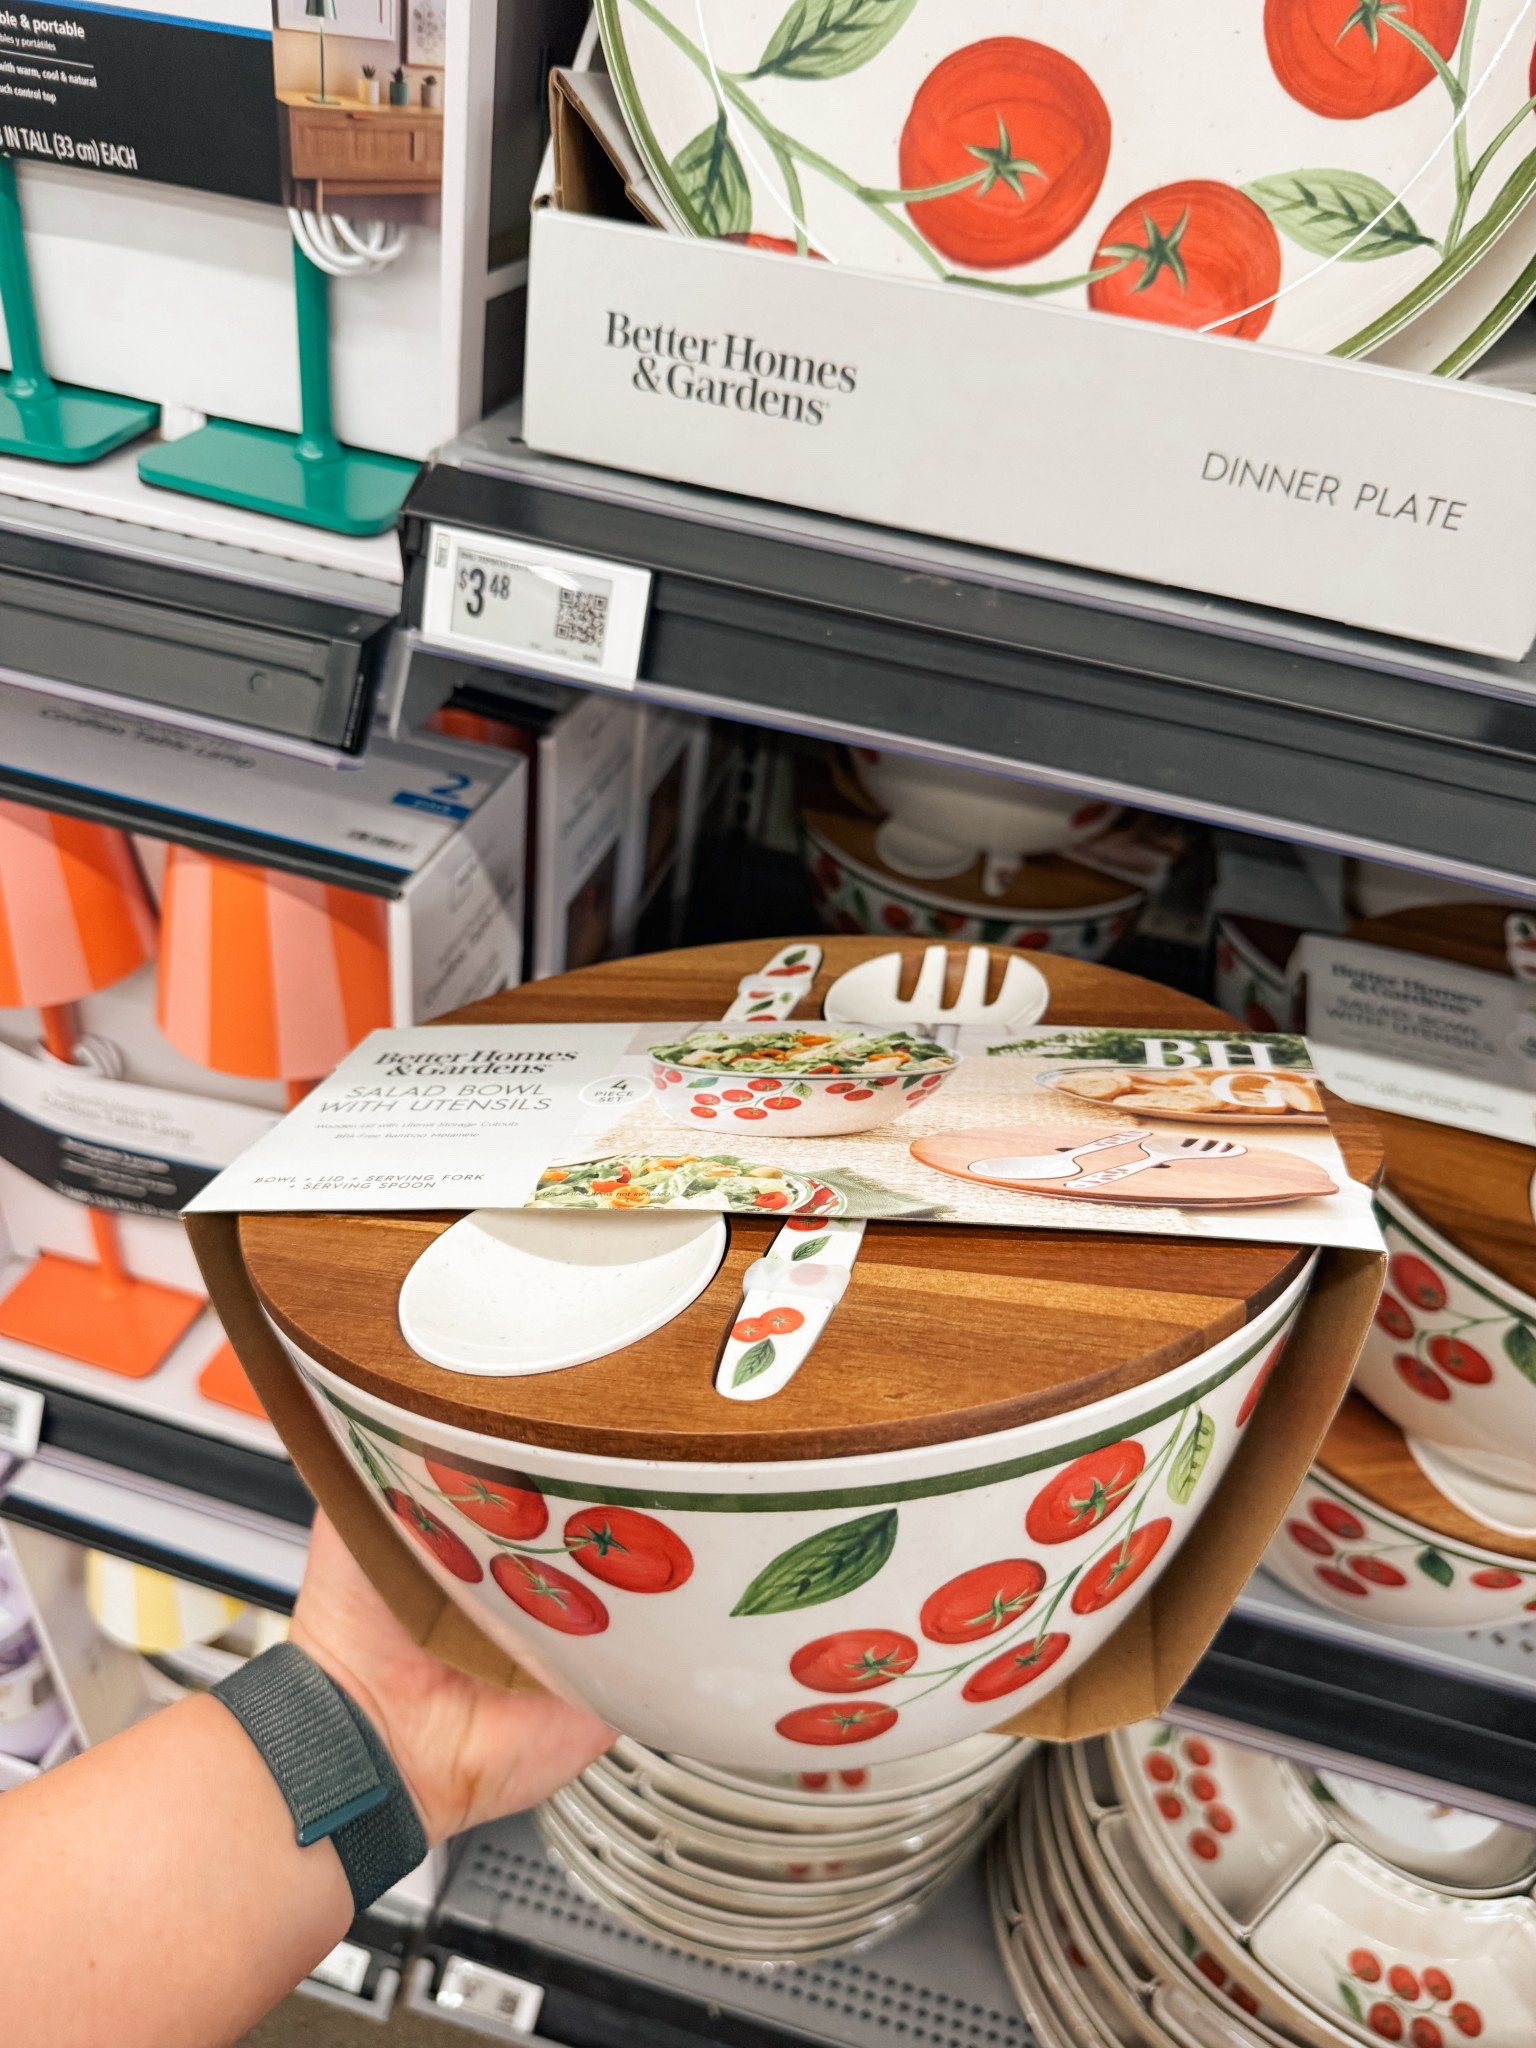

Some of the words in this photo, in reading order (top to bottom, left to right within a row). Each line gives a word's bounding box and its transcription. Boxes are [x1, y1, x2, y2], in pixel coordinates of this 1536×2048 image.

[20, 14, 30, 30] &
[32, 19, 85, 39] portable
[16, 65, 41, 79] warm,
[42, 69, 59, 82] cool
[60, 71, 68, 83] &
[68, 74, 98, 89] natural
[14, 86, 42, 100] control
[42, 90, 57, 105] top
[3, 124, 21, 150] IN
[19, 127, 53, 156] TALL
[53, 131, 75, 160] (33
[75, 137, 100, 167] cm)
[99, 141, 138, 171] EACH
[605, 310, 718, 366] Better
[722, 332, 858, 394] Homes
[1201, 451, 1340, 506] DINNER
[1353, 482, 1467, 532] PLATE
[429, 770, 471, 799] 2
[375, 1051, 468, 1066] Better
[470, 1049, 579, 1063] Homes
[346, 1084, 447, 1098] SALAD
[457, 1083, 546, 1097] BOWL
[609, 1079, 629, 1091] 4
[1209, 1073, 1288, 1115] G
[320, 1098, 399, 1113] WITH
[410, 1097, 553, 1112] UTENSILS
[253, 1175, 297, 1184] BOWL
[318, 1174, 346, 1183] LID
[364, 1174, 436, 1182] SERVING
[441, 1173, 487, 1182] FORK
[301, 1181, 372, 1190] SERVING
[377, 1181, 437, 1190] SPOON
